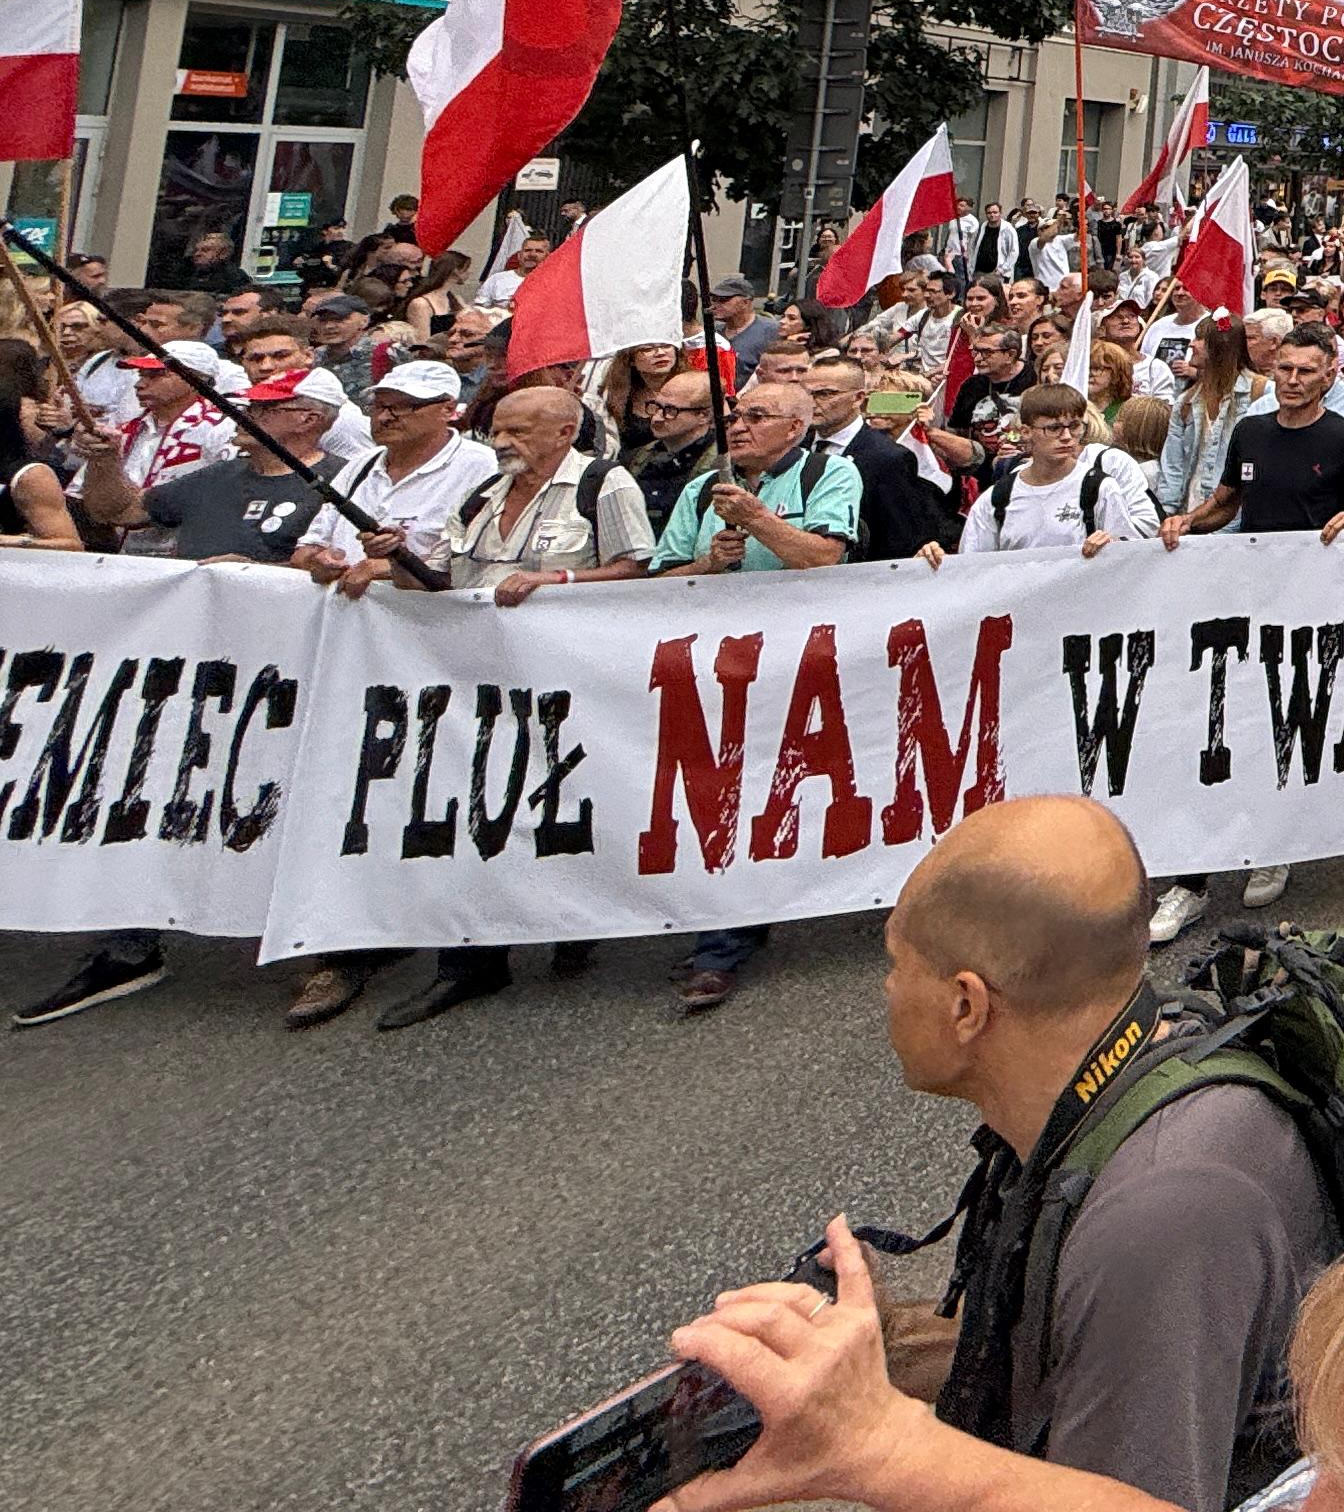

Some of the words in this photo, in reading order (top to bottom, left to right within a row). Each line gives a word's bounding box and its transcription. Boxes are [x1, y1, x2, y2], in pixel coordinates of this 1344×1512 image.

[1205, 40, 1226, 56] IM.
[1229, 46, 1290, 69] JANUSZA
[0, 644, 298, 852] EMIEC
[340, 685, 594, 861] PLUŁ
[638, 614, 1012, 875] NAM
[1062, 630, 1155, 798] W
[1075, 1021, 1142, 1104] Nikon
